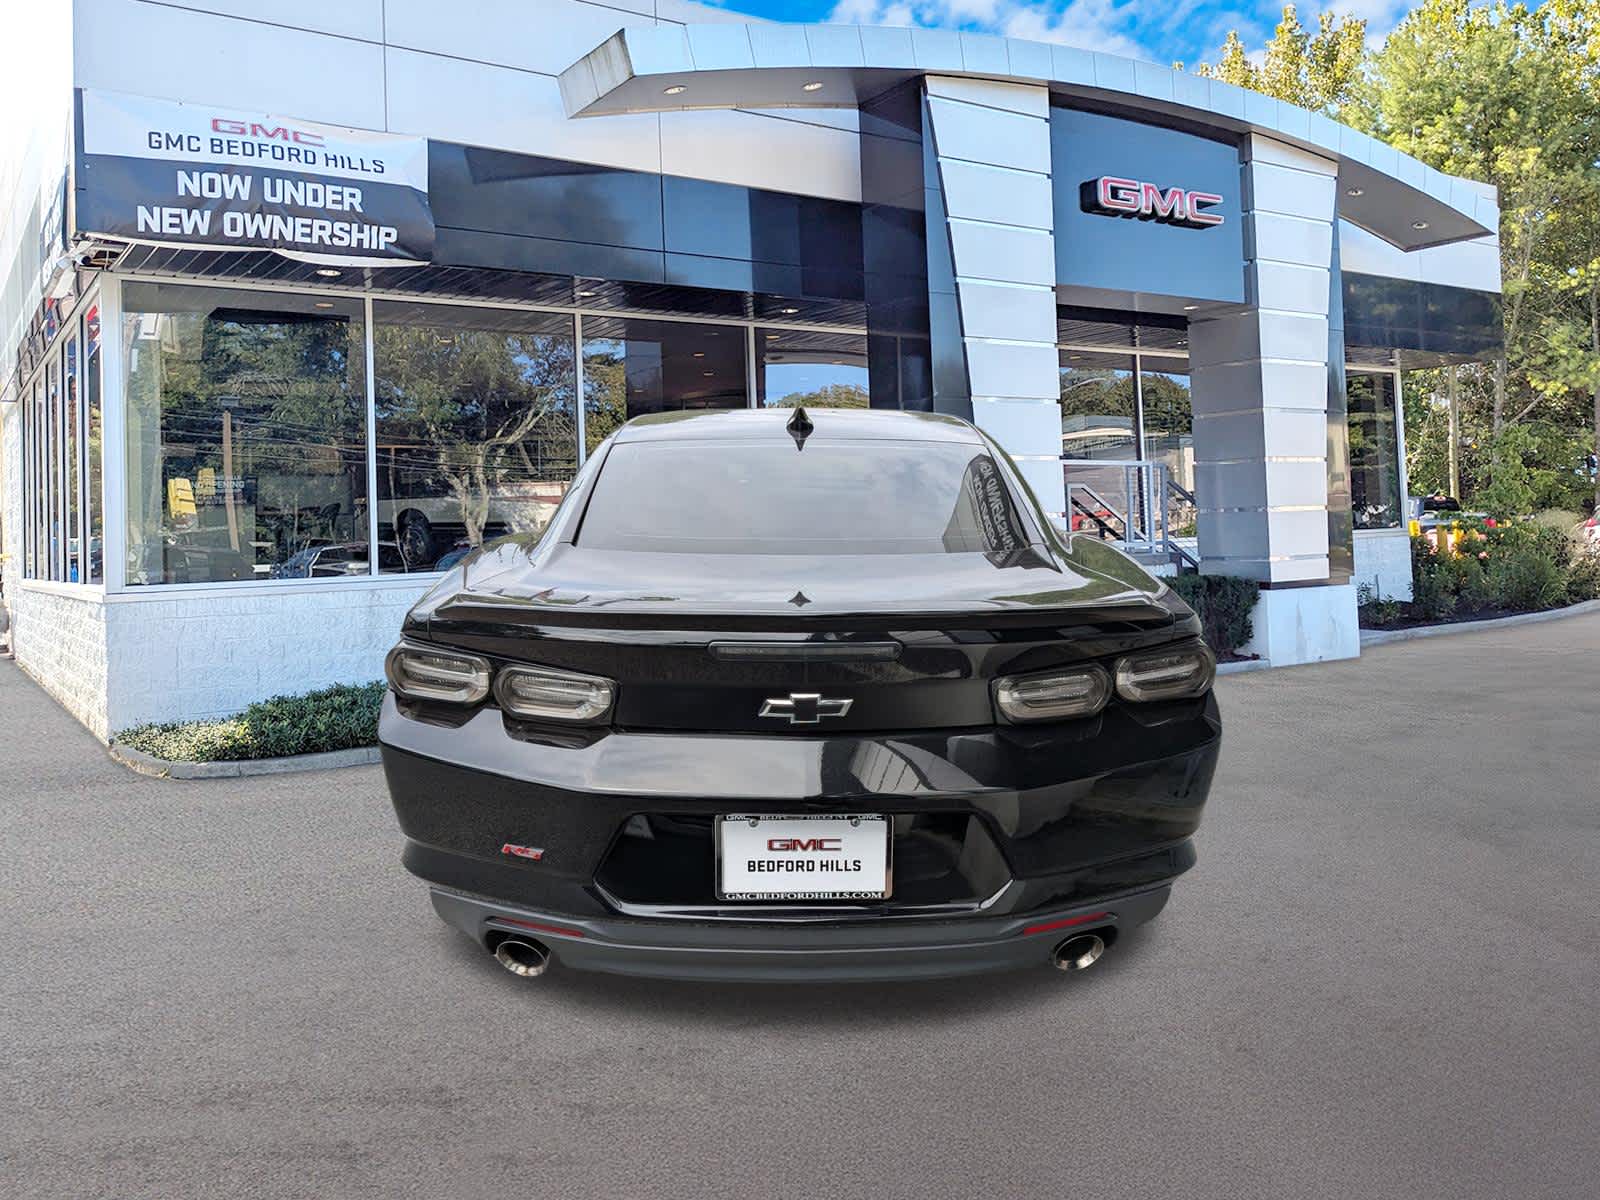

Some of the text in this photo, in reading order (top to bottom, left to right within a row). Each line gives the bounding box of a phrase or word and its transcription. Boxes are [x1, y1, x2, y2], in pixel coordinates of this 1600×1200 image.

[211, 118, 326, 148] GMC
[148, 131, 385, 174] GMC BEDFORD HILLS
[177, 170, 364, 213] NOW UNDER
[1097, 175, 1225, 225] GMC
[136, 205, 398, 251] NEW OWNERSHIP
[501, 843, 545, 861] RS
[767, 838, 842, 851] GMC
[748, 860, 862, 872] BEDFORD HILLS
[726, 891, 882, 900] GMCBEDFORDHILLS.COM
